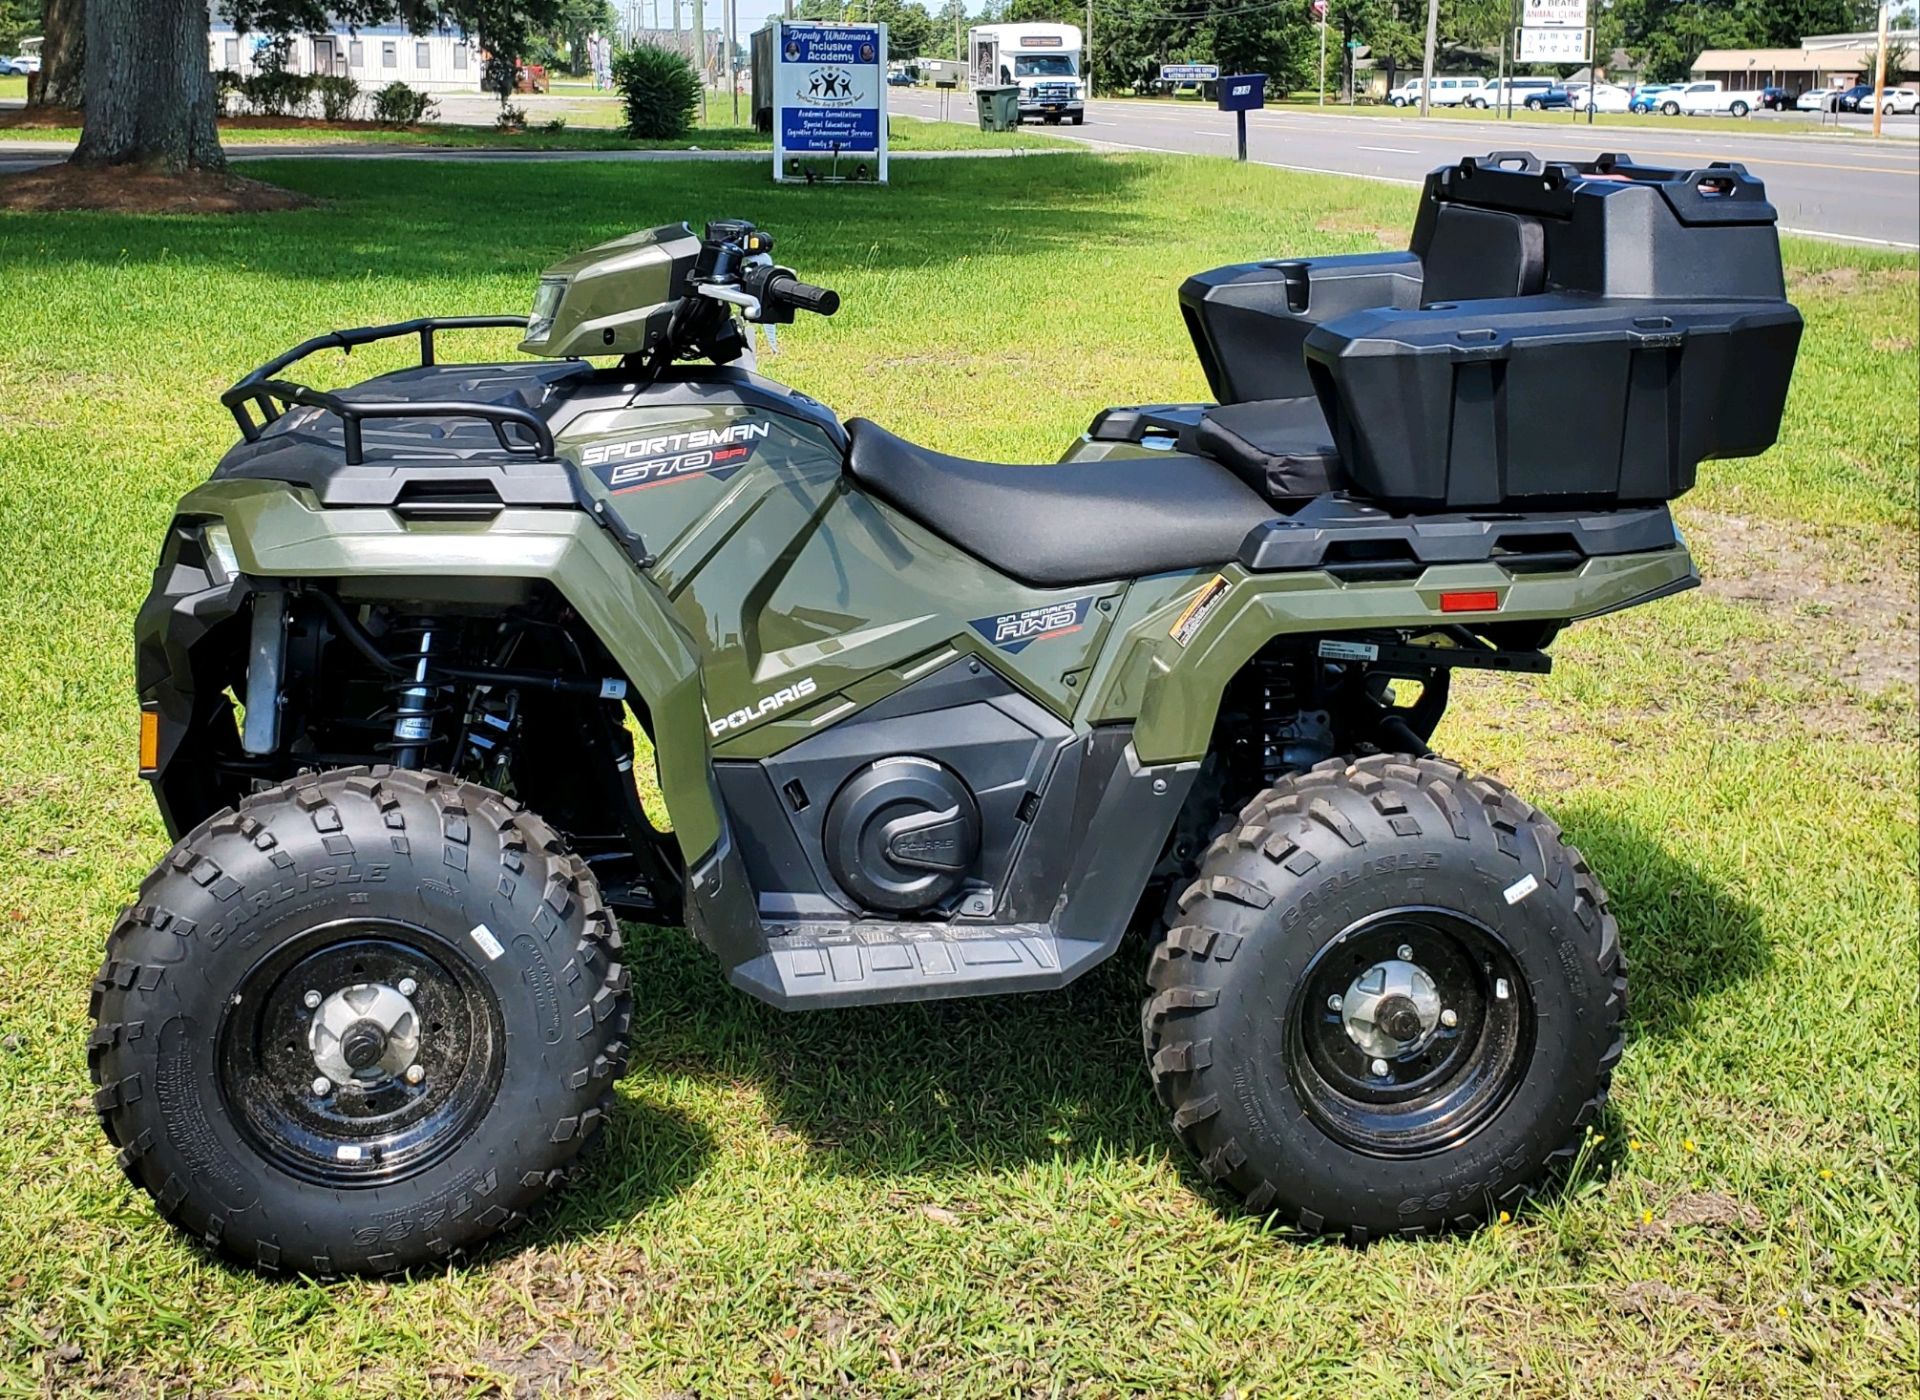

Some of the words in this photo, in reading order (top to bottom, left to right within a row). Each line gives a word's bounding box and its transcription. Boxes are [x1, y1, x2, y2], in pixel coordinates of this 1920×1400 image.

[1526, 10, 1554, 18] ANIMAL
[1558, 10, 1583, 18] CLINIC
[790, 30, 821, 42] Deputy
[823, 30, 872, 41] Whiteman's
[809, 41, 853, 51] Inclusive
[807, 51, 854, 64] Academy
[803, 120, 823, 129] Special
[825, 120, 851, 128] Education
[808, 139, 827, 149] Family
[581, 422, 769, 466] SPORTSMAN
[611, 450, 713, 485] 570
[713, 447, 748, 461] EFI
[996, 614, 1016, 624] ON
[1020, 602, 1077, 619] DEMAND
[995, 609, 1077, 641] AWD
[709, 677, 817, 737] POLARIS
[1280, 850, 1443, 933] CARLISLE
[204, 863, 391, 951] CARLISLE
